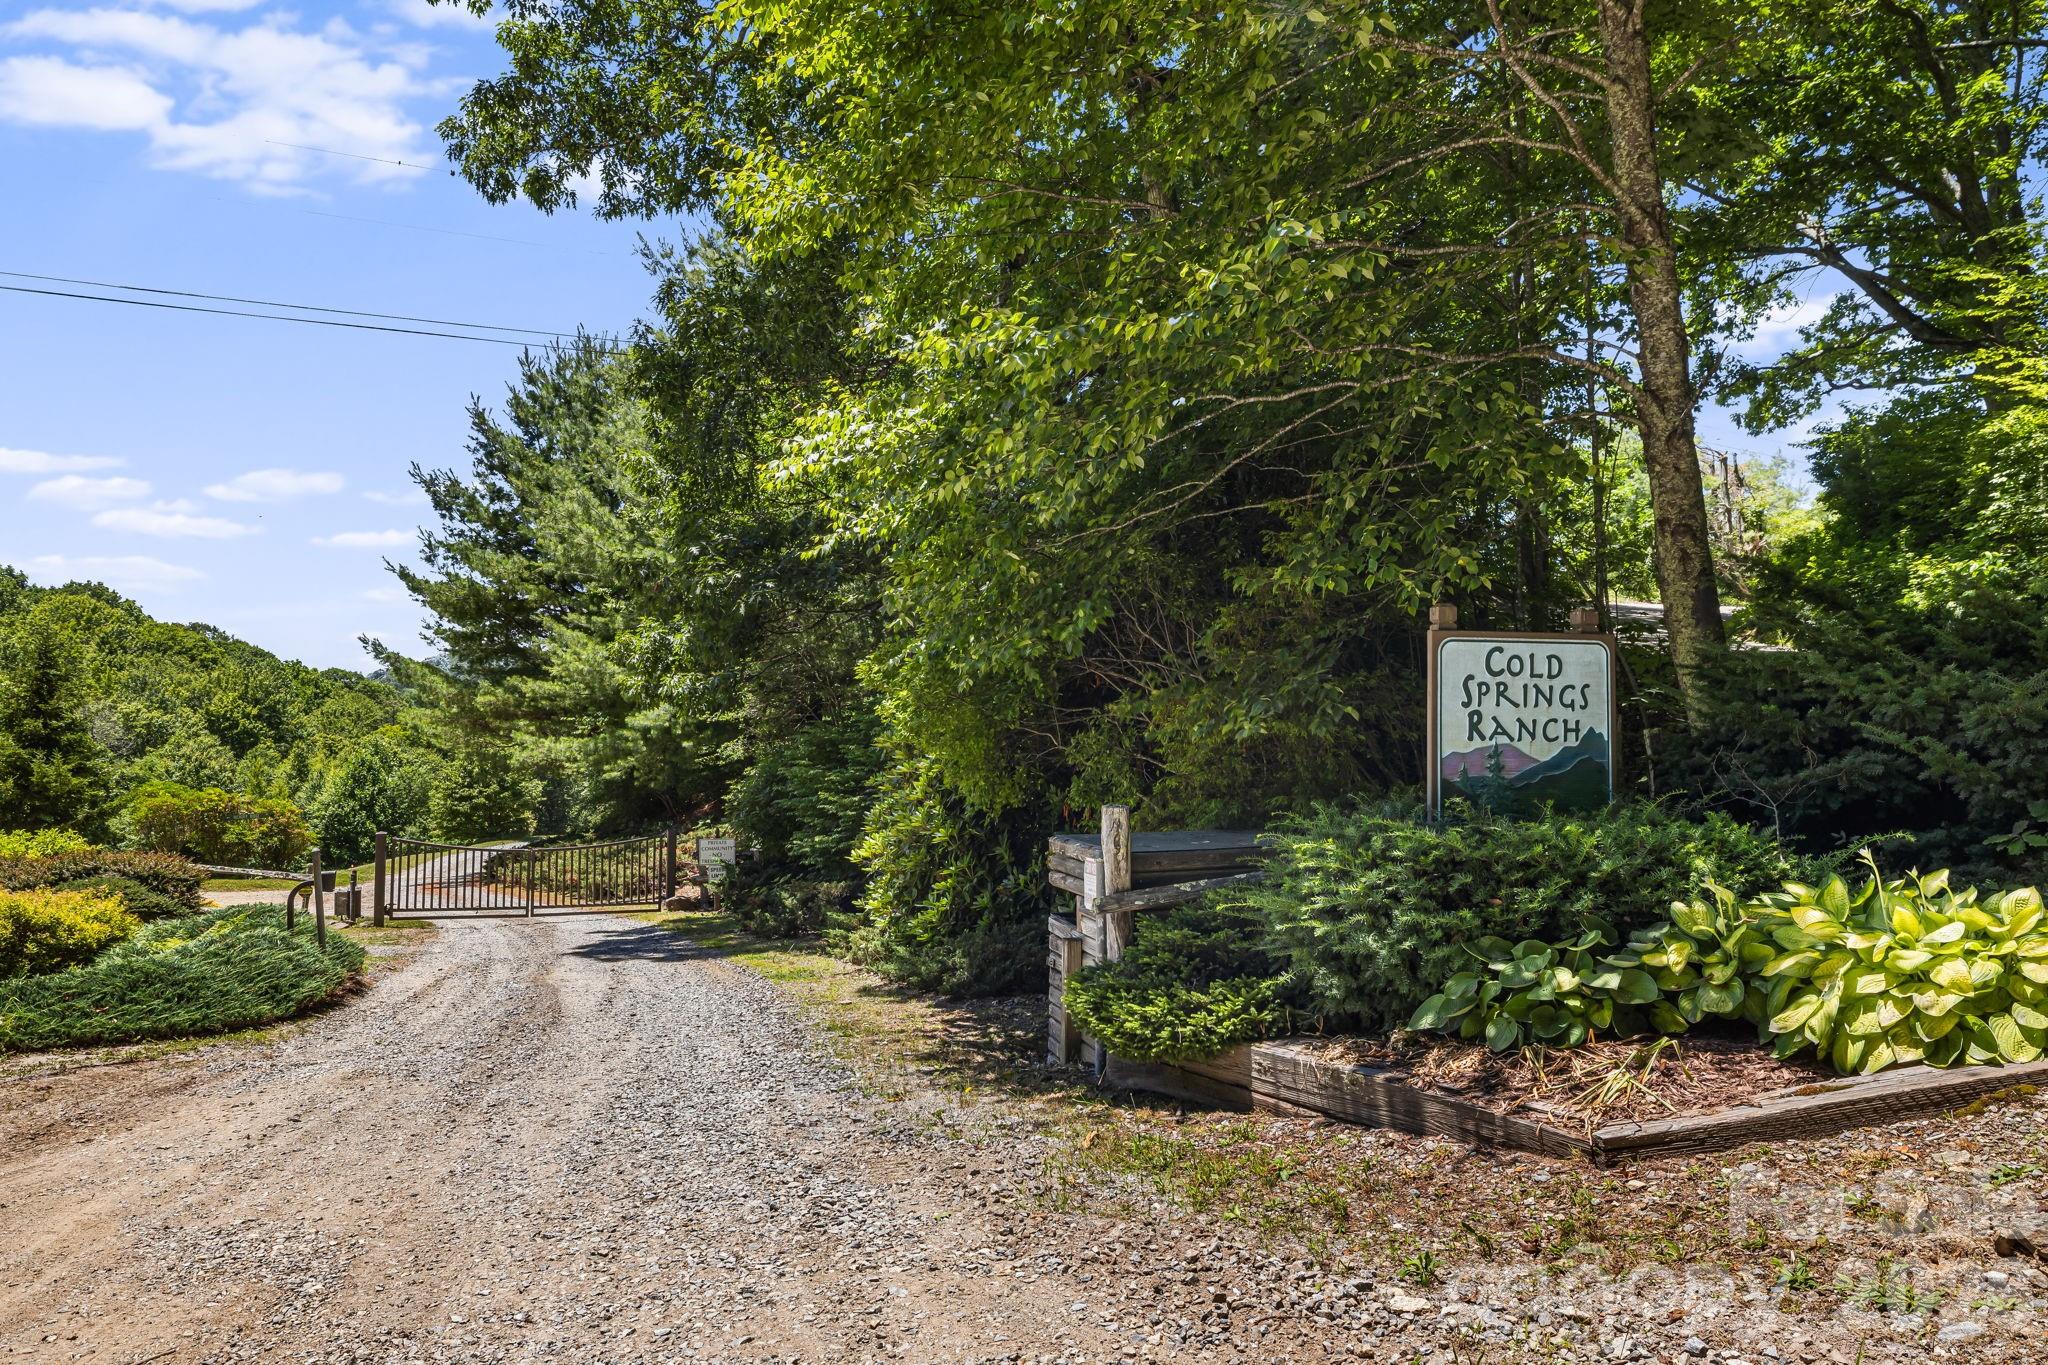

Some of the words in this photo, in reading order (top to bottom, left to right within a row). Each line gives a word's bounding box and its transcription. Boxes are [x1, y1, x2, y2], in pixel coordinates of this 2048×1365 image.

[1485, 646, 1563, 679] COLD
[1460, 674, 1591, 712] SPRINGS
[1466, 709, 1581, 743] RANCH
